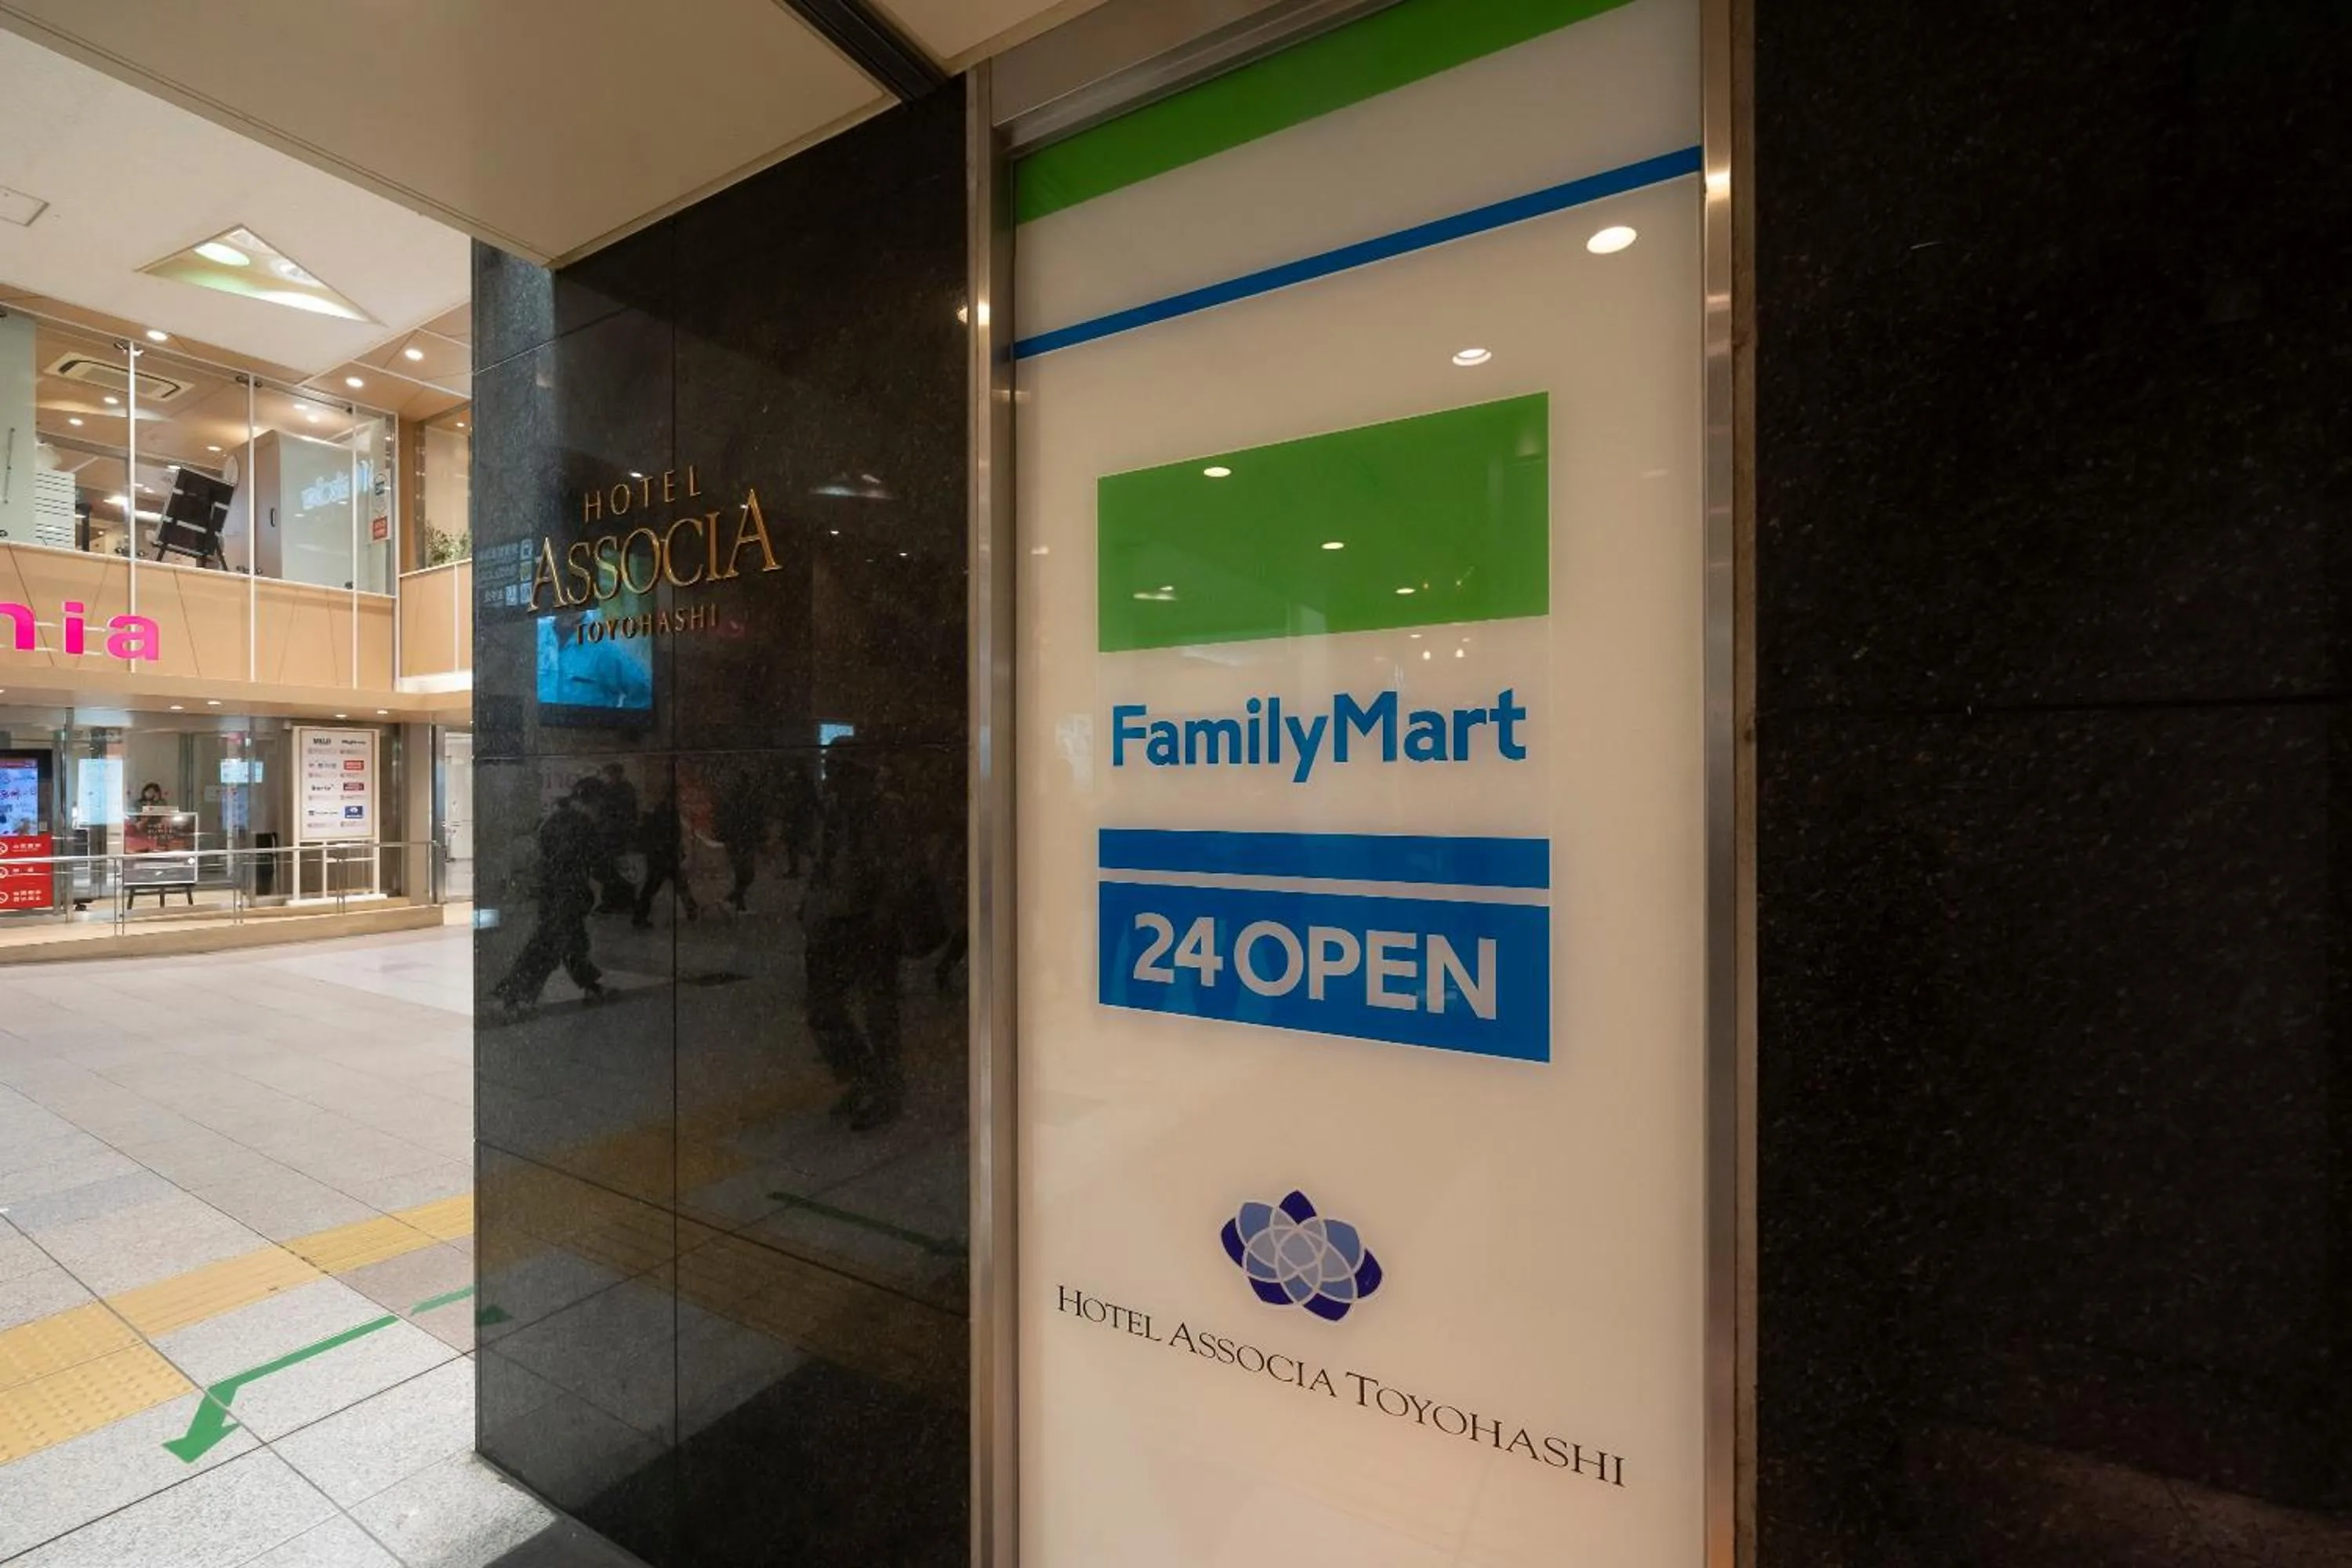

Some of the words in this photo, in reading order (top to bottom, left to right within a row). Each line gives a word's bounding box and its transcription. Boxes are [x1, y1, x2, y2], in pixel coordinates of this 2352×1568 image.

[583, 464, 702, 524] HOTEL
[526, 488, 783, 613] ASSOCIA
[575, 601, 720, 646] TOYOHASHI
[1112, 688, 1527, 783] FamilyMart
[1057, 1284, 1163, 1343] HOTEL
[1168, 1321, 1338, 1399] ASSOCIA
[1345, 1370, 1627, 1488] TOYOHASHI
